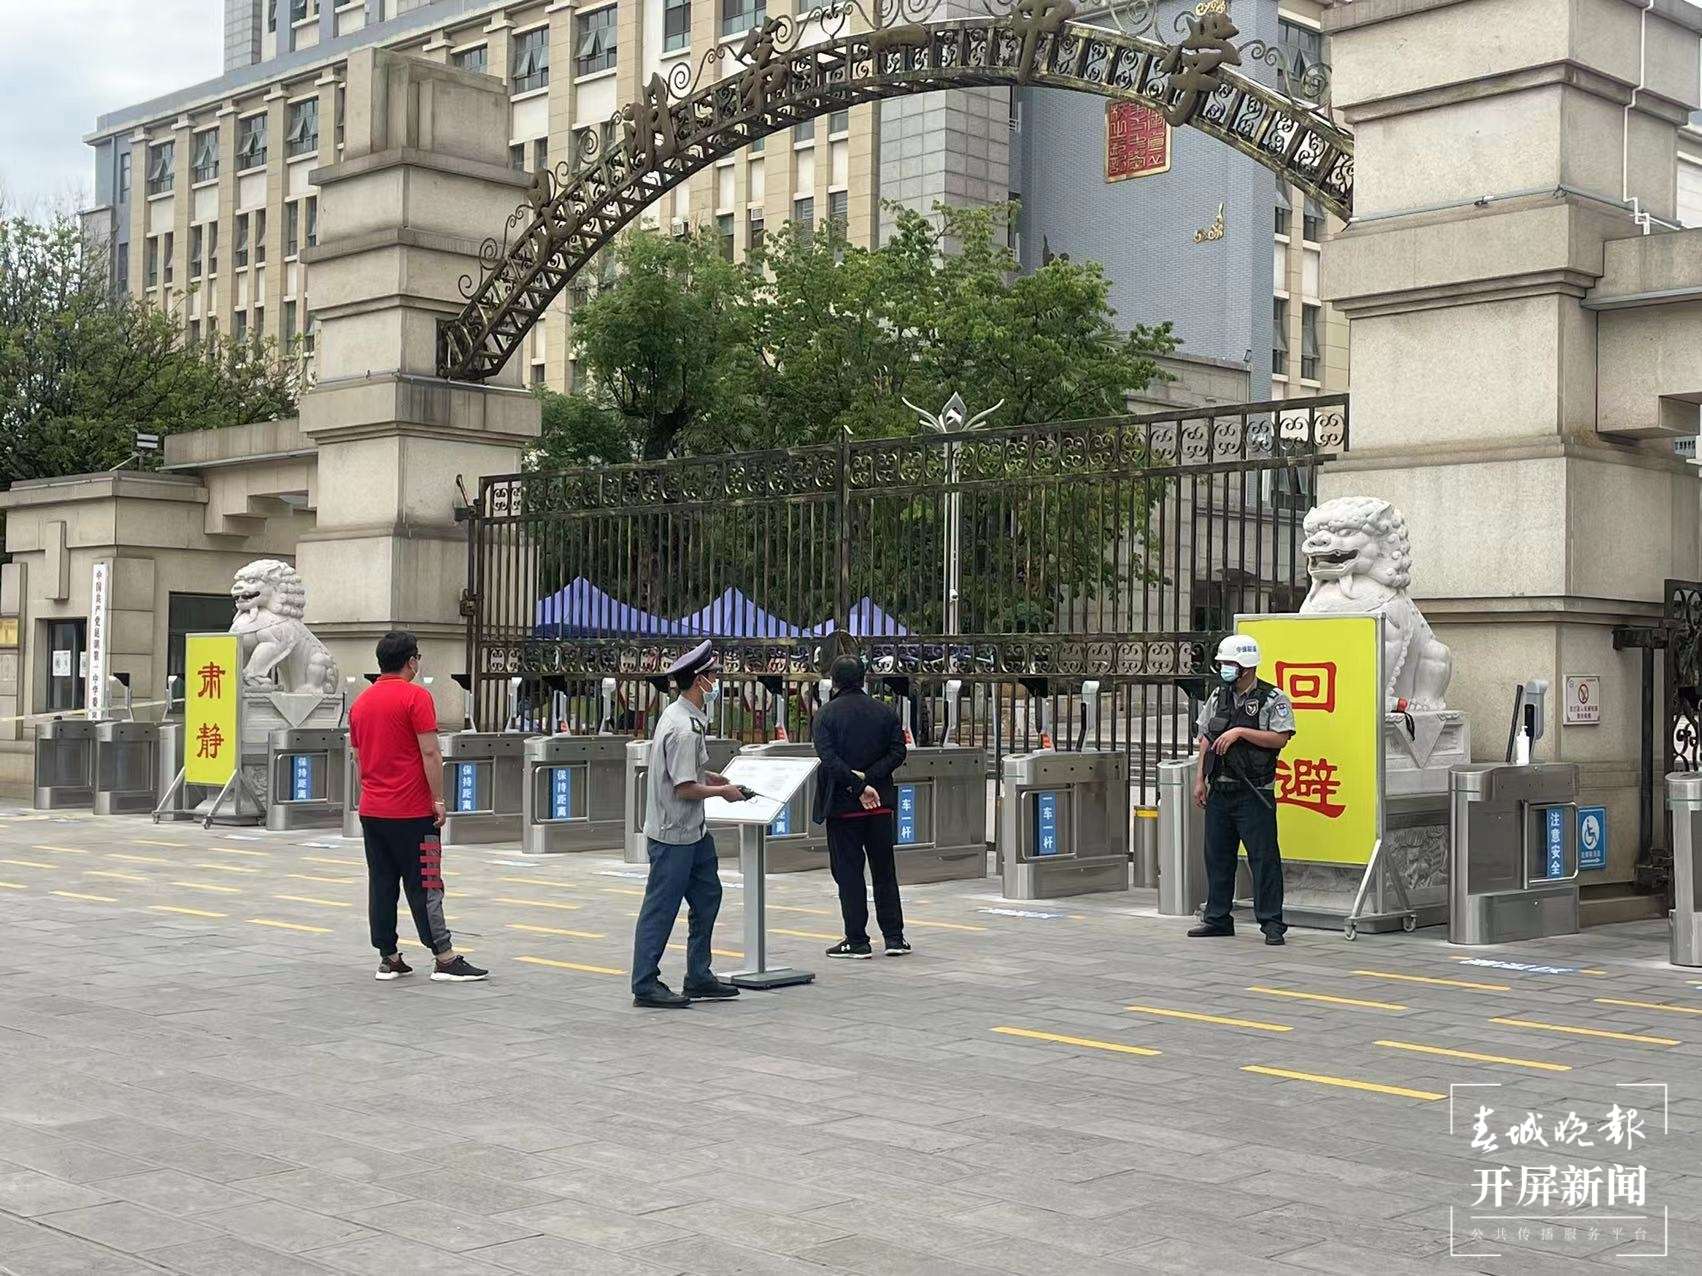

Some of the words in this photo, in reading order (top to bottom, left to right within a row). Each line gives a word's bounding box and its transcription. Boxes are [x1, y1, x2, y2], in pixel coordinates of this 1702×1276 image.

[196, 661, 226, 759] 肃静
[1275, 660, 1346, 819] 回避
[297, 756, 307, 799] 保持距离
[462, 764, 473, 811] 保持距离
[556, 769, 567, 817] 保持距离
[901, 788, 912, 839] 一车一杆
[1042, 796, 1053, 849] 一车一杆
[1550, 811, 1560, 875] 注意安全
